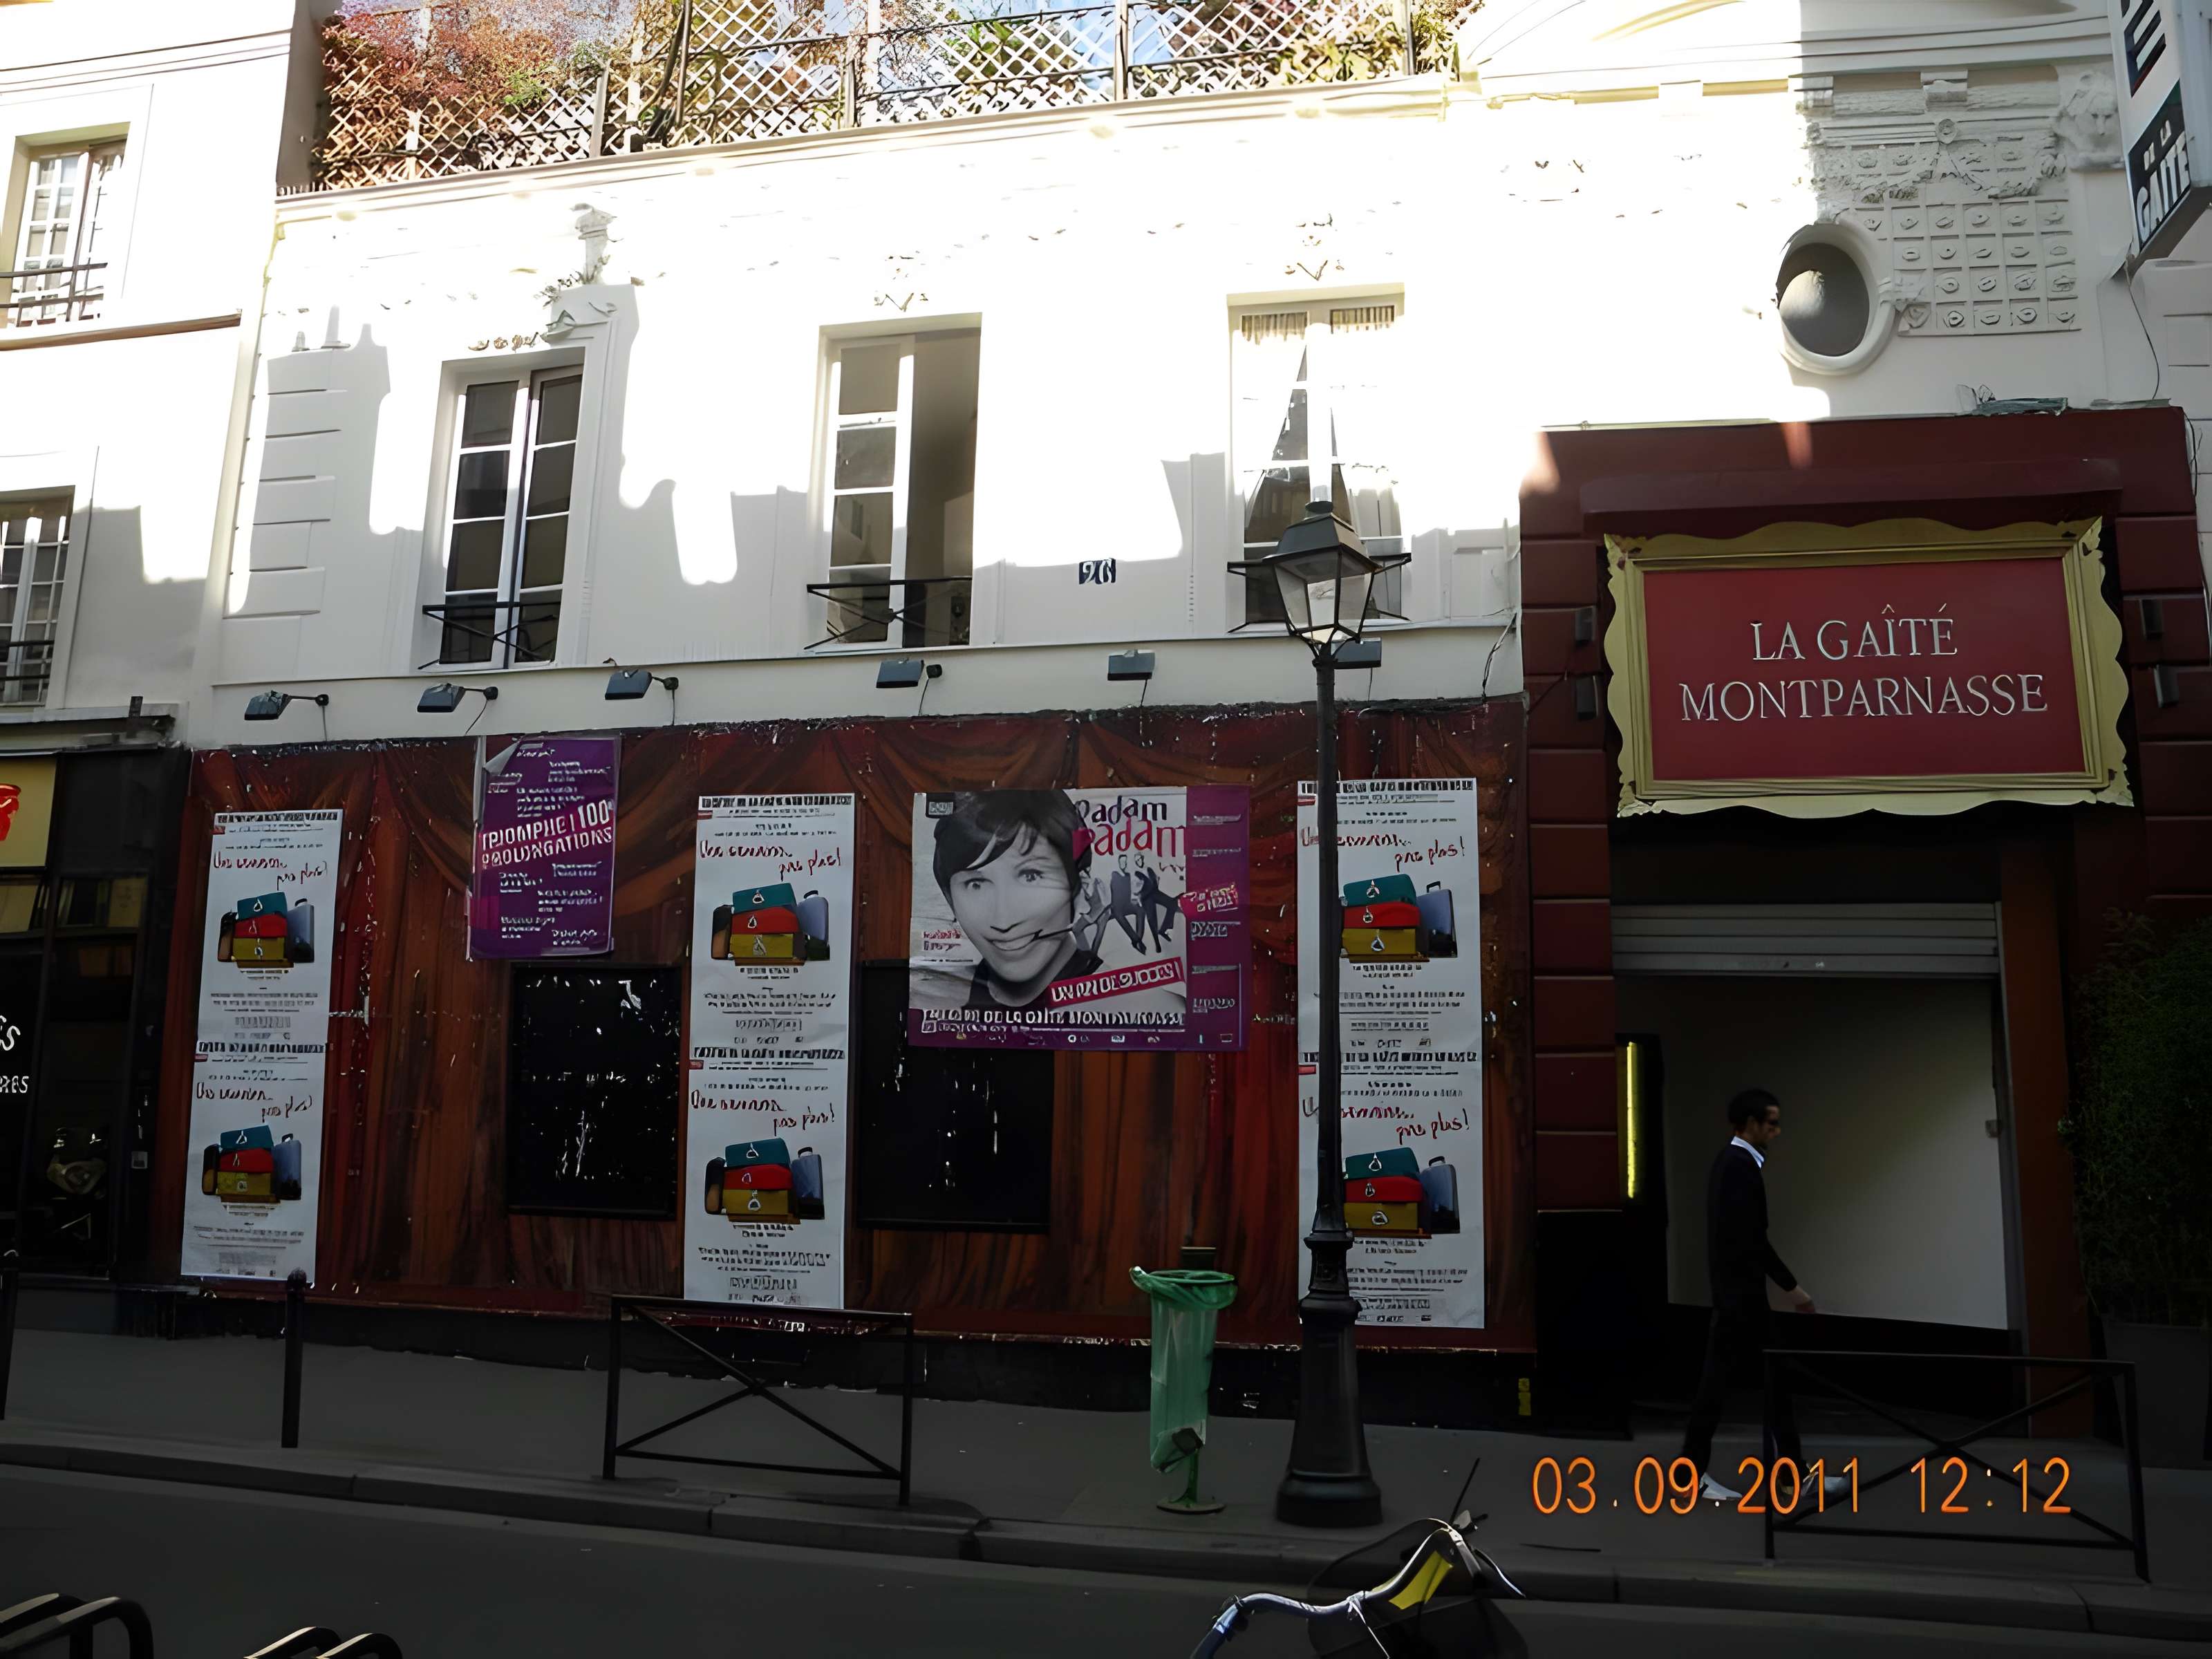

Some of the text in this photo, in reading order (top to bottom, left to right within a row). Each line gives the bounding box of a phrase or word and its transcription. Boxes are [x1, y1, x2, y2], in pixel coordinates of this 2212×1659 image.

[1752, 603, 1958, 662] LA GAÎTÉ
[1679, 674, 2048, 722] MONTPARNASSE
